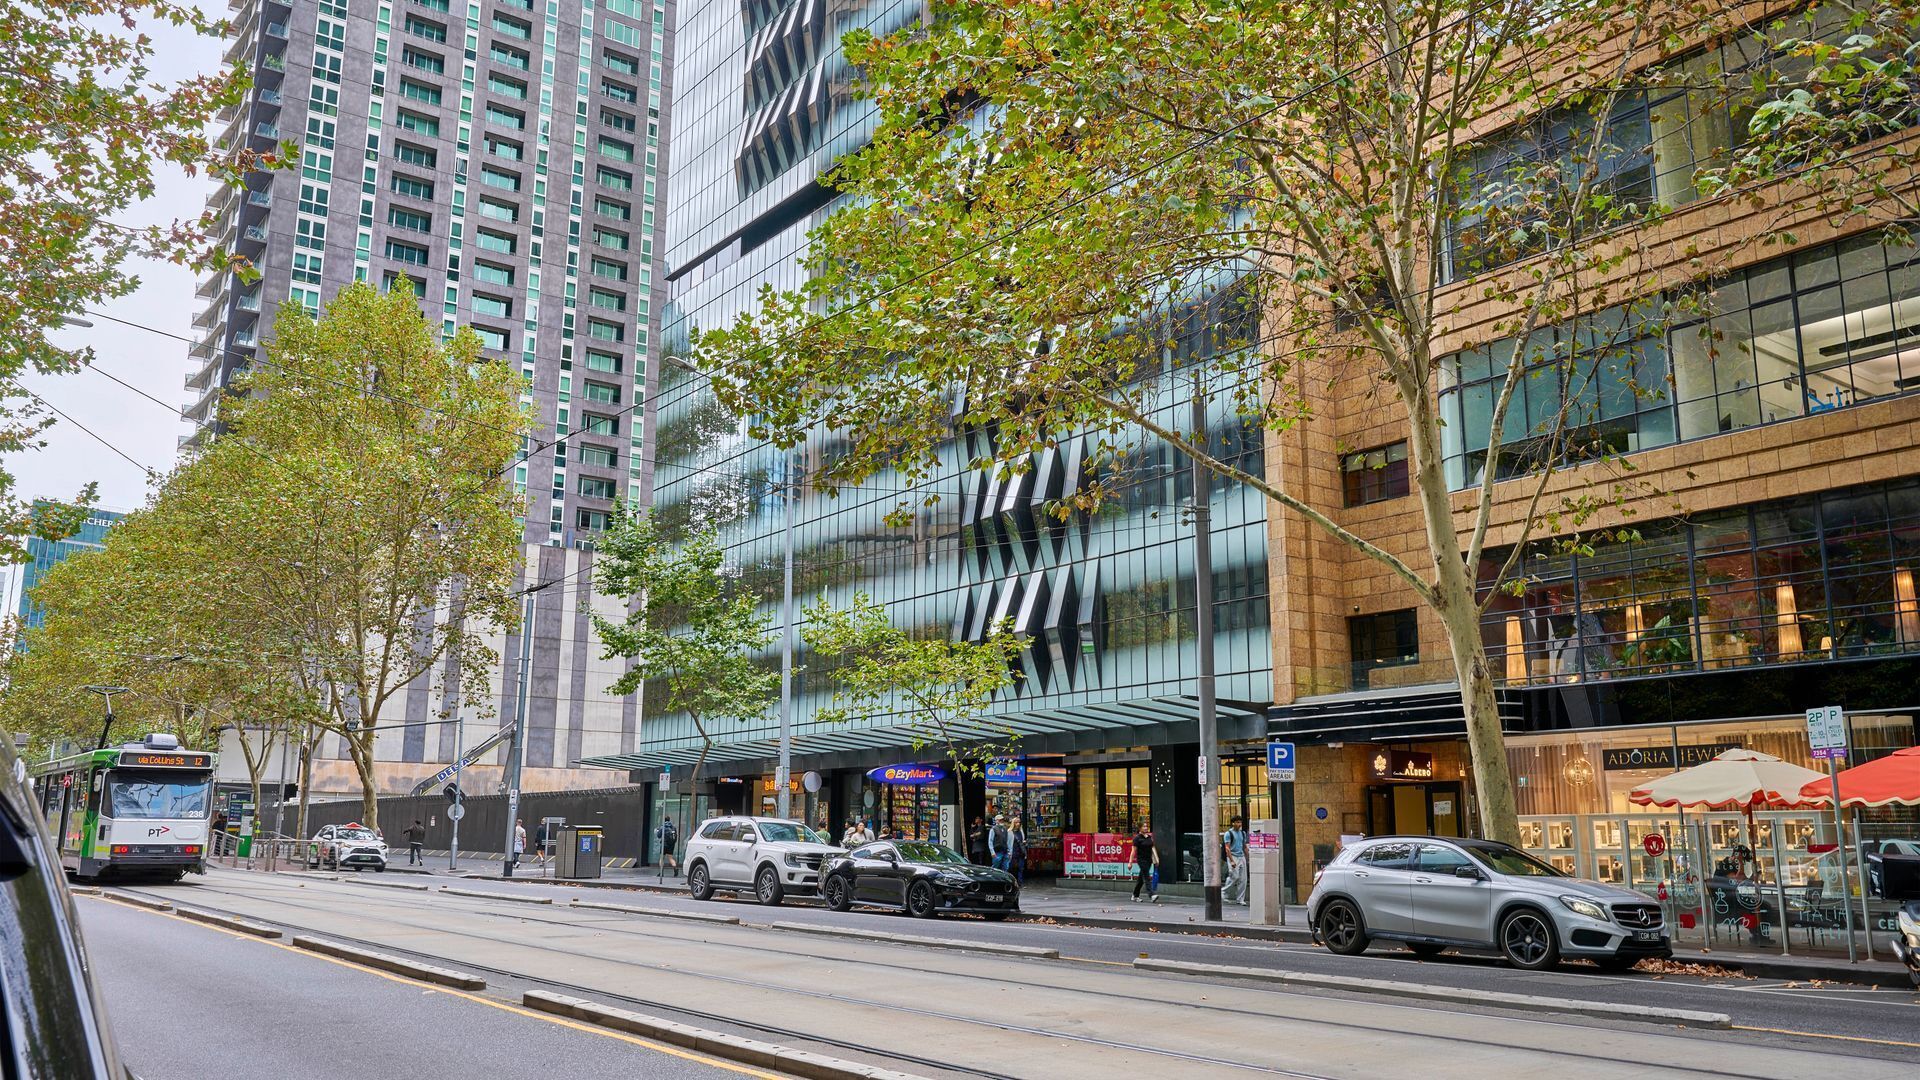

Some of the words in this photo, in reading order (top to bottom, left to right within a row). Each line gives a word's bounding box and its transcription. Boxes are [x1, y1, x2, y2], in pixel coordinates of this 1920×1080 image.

[1808, 712, 1823, 722] 2P
[1829, 710, 1837, 720] P
[149, 756, 175, 765] Collins
[175, 756, 185, 765] St
[1274, 747, 1288, 765] P
[1608, 749, 1669, 765] ADORIA
[438, 759, 470, 781] DELA
[188, 810, 204, 818] 238
[1070, 842, 1086, 855] For
[1094, 842, 1123, 855] Lease
